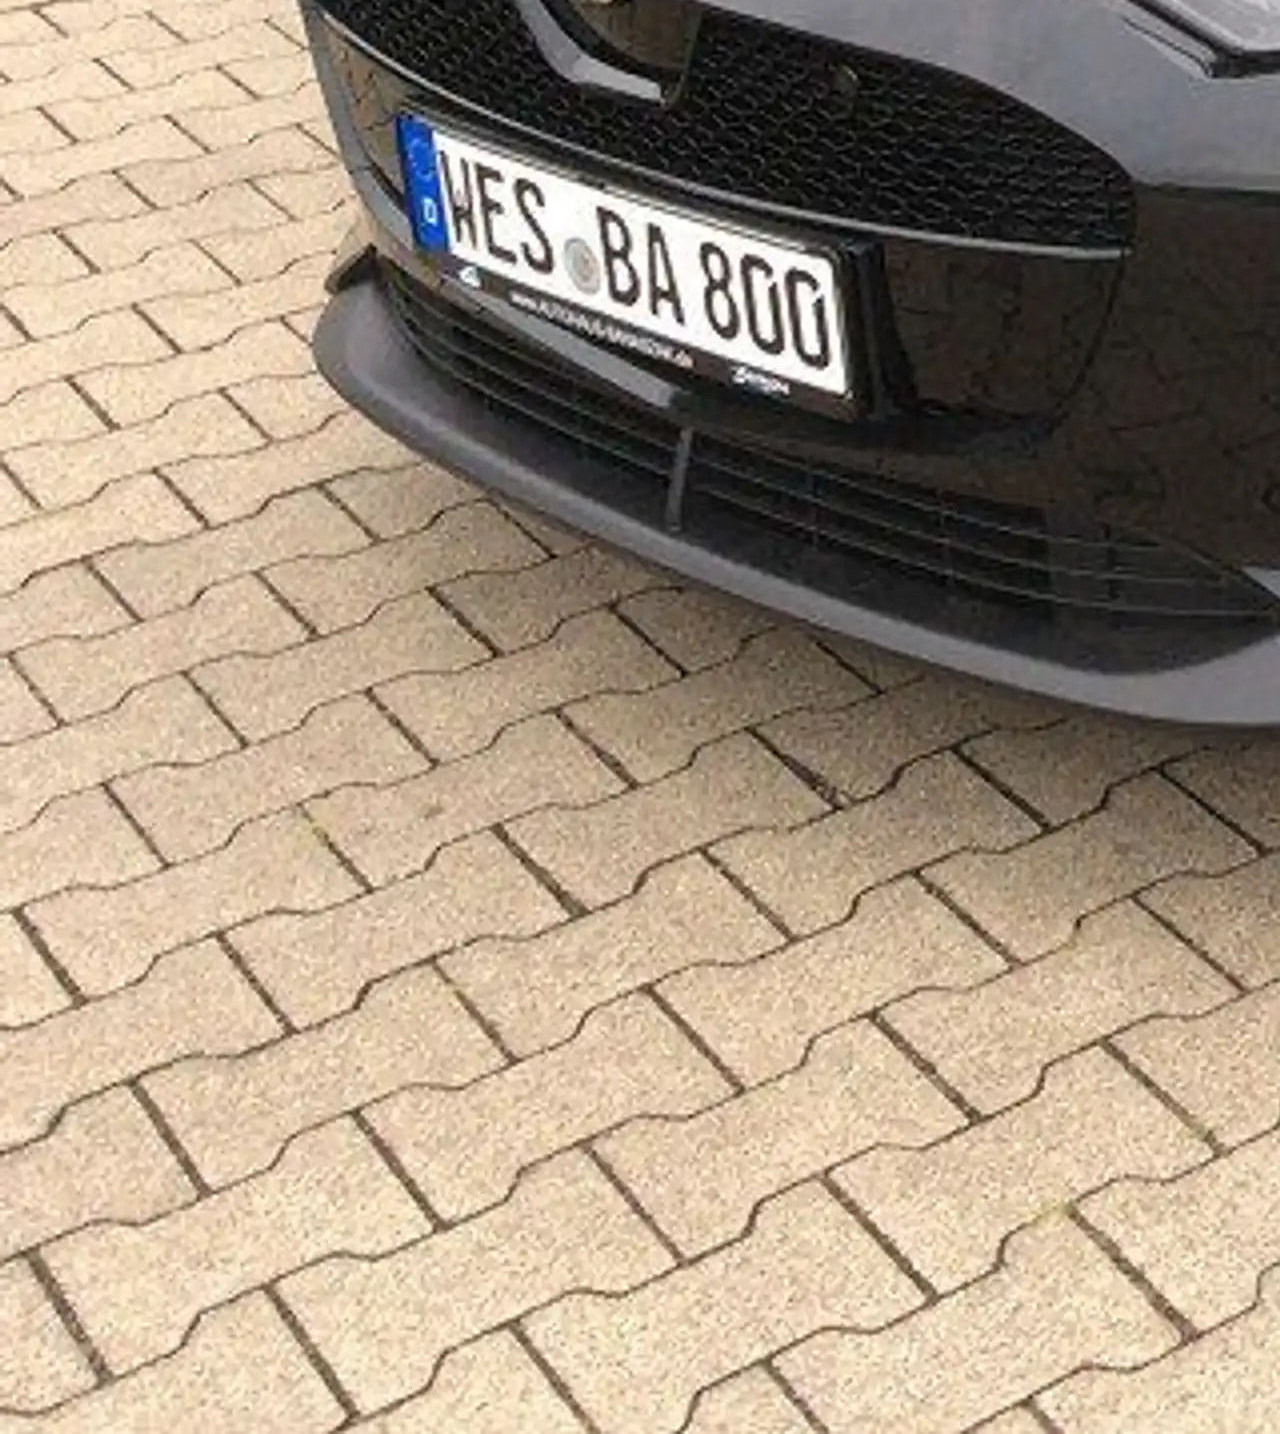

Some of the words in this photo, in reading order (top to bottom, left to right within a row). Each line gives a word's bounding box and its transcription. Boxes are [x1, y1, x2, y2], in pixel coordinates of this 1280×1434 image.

[439, 150, 554, 273] WES
[596, 206, 685, 325] BA
[701, 242, 830, 369] 800
